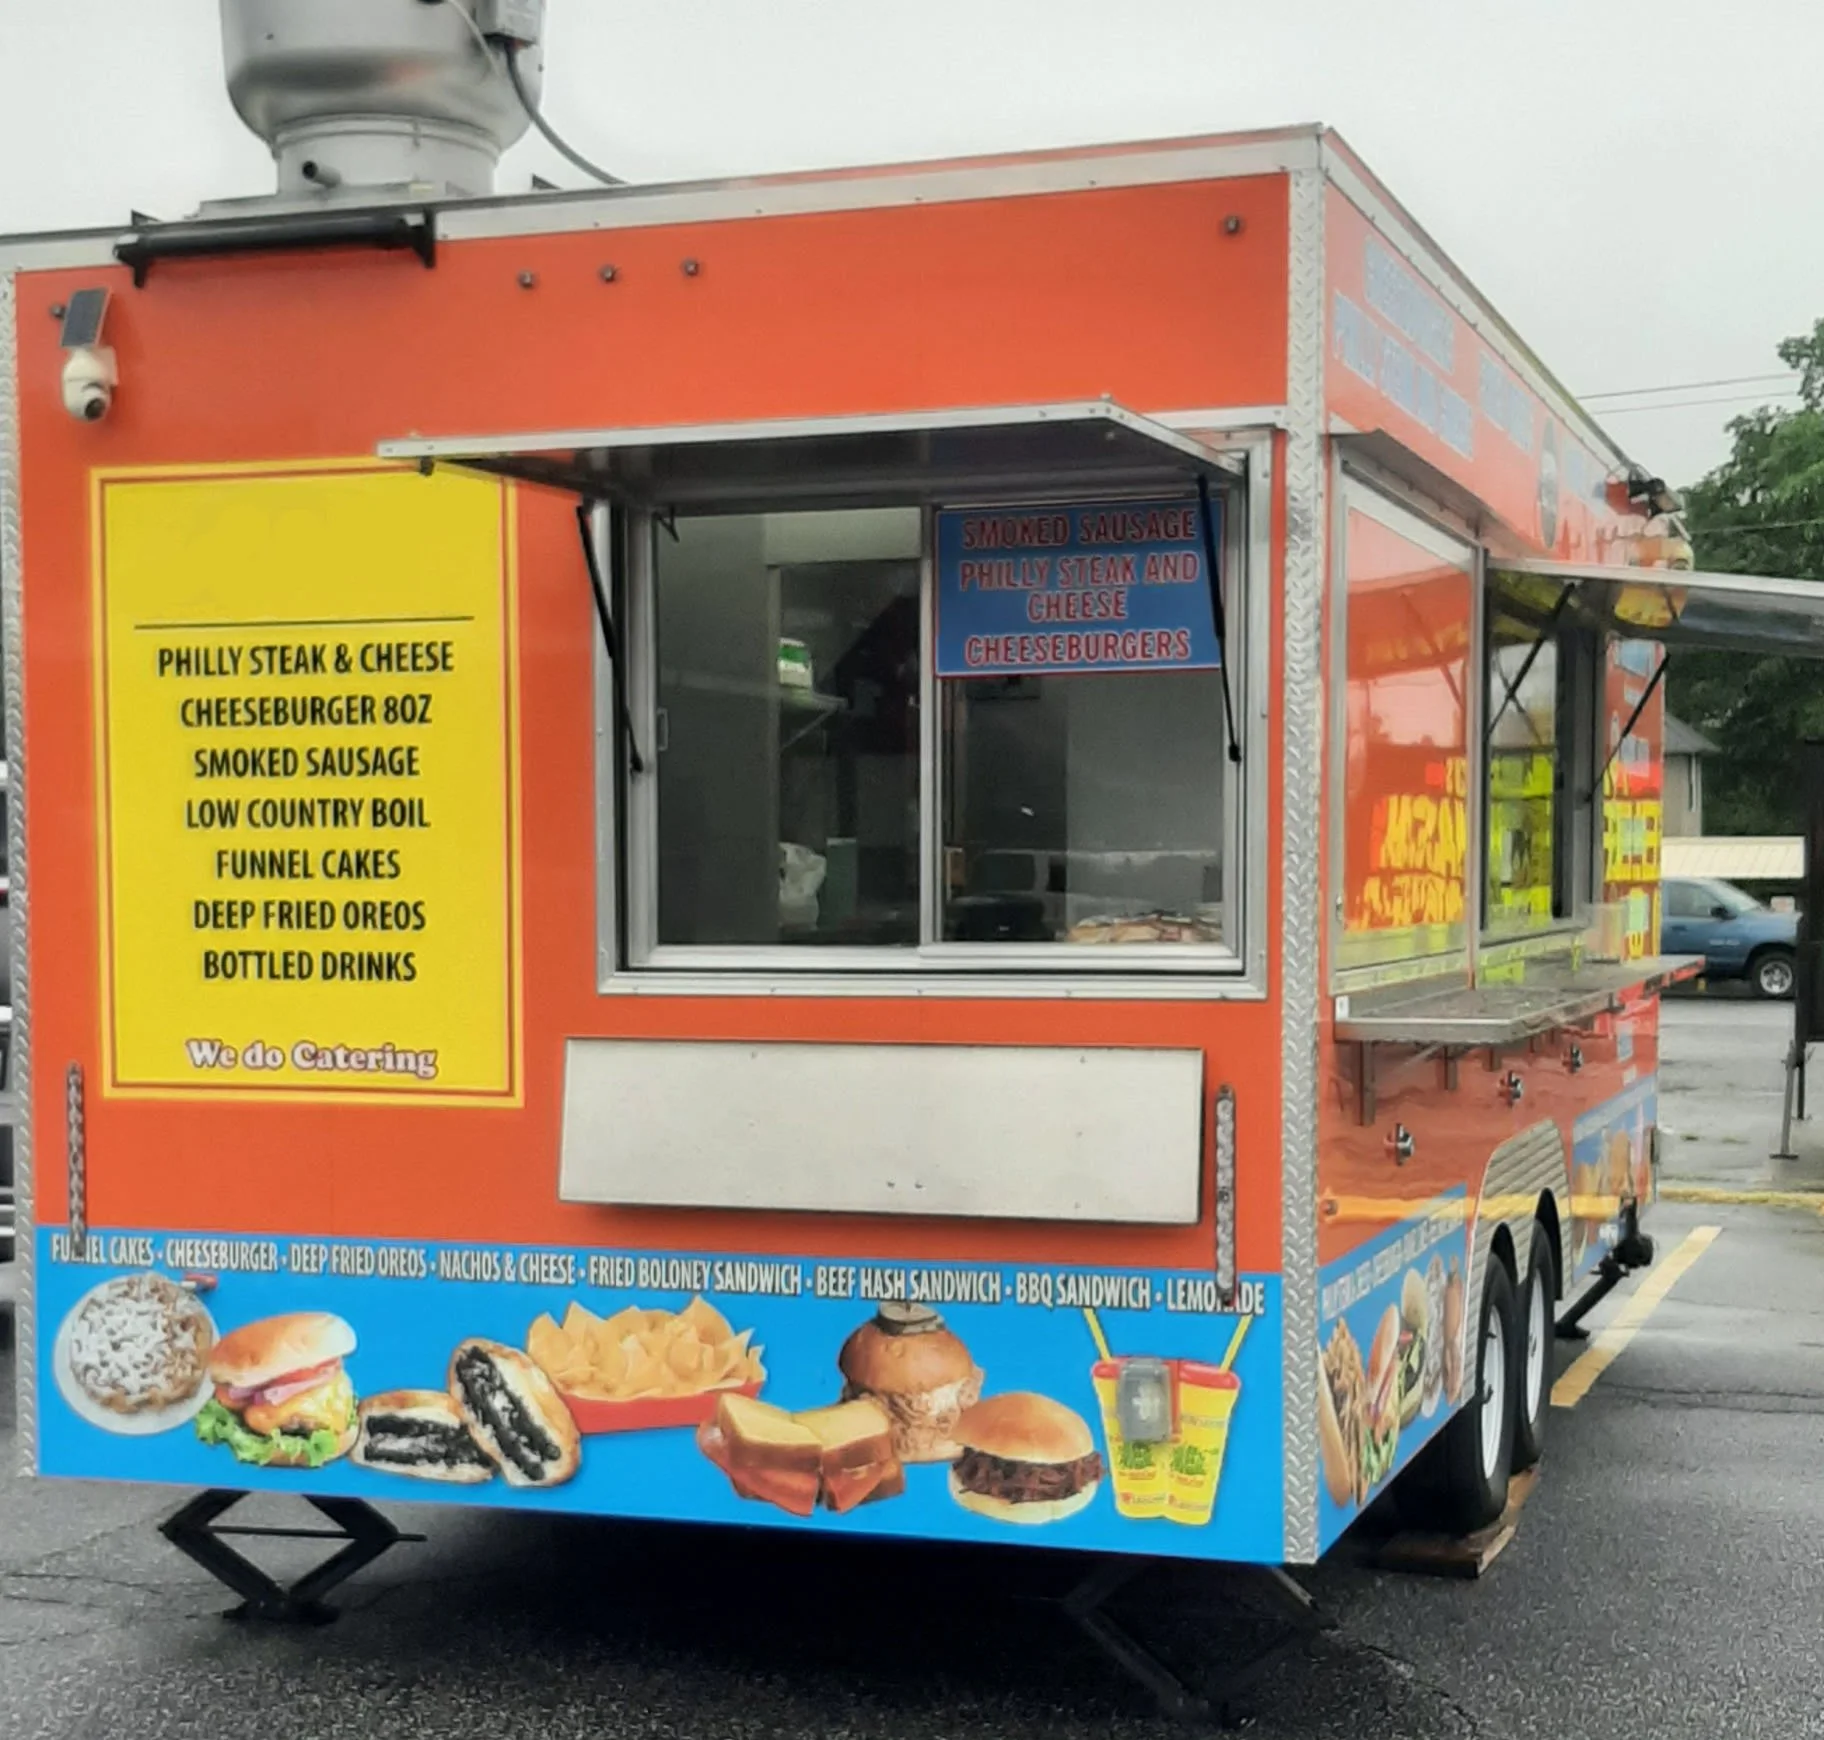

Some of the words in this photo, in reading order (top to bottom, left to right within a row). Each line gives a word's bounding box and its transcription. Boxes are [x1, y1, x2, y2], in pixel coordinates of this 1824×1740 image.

[962, 515, 1070, 549] SMOKED
[1079, 509, 1196, 544] SAUSAGE
[960, 557, 1049, 591] PHILLY
[1058, 554, 1137, 589] STEAK
[1143, 550, 1200, 584] AND
[1027, 588, 1128, 623] CHEESE
[158, 646, 243, 677] PHILLY
[250, 644, 327, 675] STEAK
[334, 643, 352, 674] &
[360, 641, 455, 673] CHEESE
[964, 627, 1191, 666] CHEESEBURGERS
[181, 696, 376, 727] CHEESEBURGER
[194, 748, 298, 778] SMOKED
[306, 746, 420, 777] SAUSAGE
[186, 799, 239, 828] LOW
[247, 798, 364, 828] COUNTRY
[371, 798, 430, 828] BOIL
[216, 850, 313, 879] FUNNEL
[322, 849, 400, 879] CAKES
[194, 900, 255, 930] DEEP
[263, 900, 336, 930] FRIED
[343, 900, 426, 931] OREOS
[203, 950, 313, 980] BOTTLED
[321, 951, 417, 982] DRINKS
[186, 1038, 237, 1068] We
[242, 1040, 285, 1069] do
[291, 1040, 438, 1079] Catering
[52, 1234, 106, 1264] FUEL
[110, 1236, 153, 1266] CAKES
[165, 1239, 278, 1272] CHEESEBURGER
[291, 1243, 328, 1273] DEEP
[331, 1244, 377, 1275] FRIED
[378, 1246, 427, 1278] OREOS
[440, 1250, 501, 1280] NACHOS
[504, 1253, 516, 1282] &
[519, 1254, 576, 1285] CHEESE
[589, 1256, 635, 1288] FRIED
[639, 1258, 713, 1291] BOLONEY
[714, 1261, 802, 1296] SANDWICH
[816, 1265, 856, 1298] BEEF
[860, 1268, 904, 1300] HASH
[909, 1270, 1001, 1303] SANDWICH
[1015, 1274, 1053, 1308] BBQ
[1056, 1274, 1152, 1309] SANDWICH
[1167, 1278, 1265, 1315] LEMOADE
